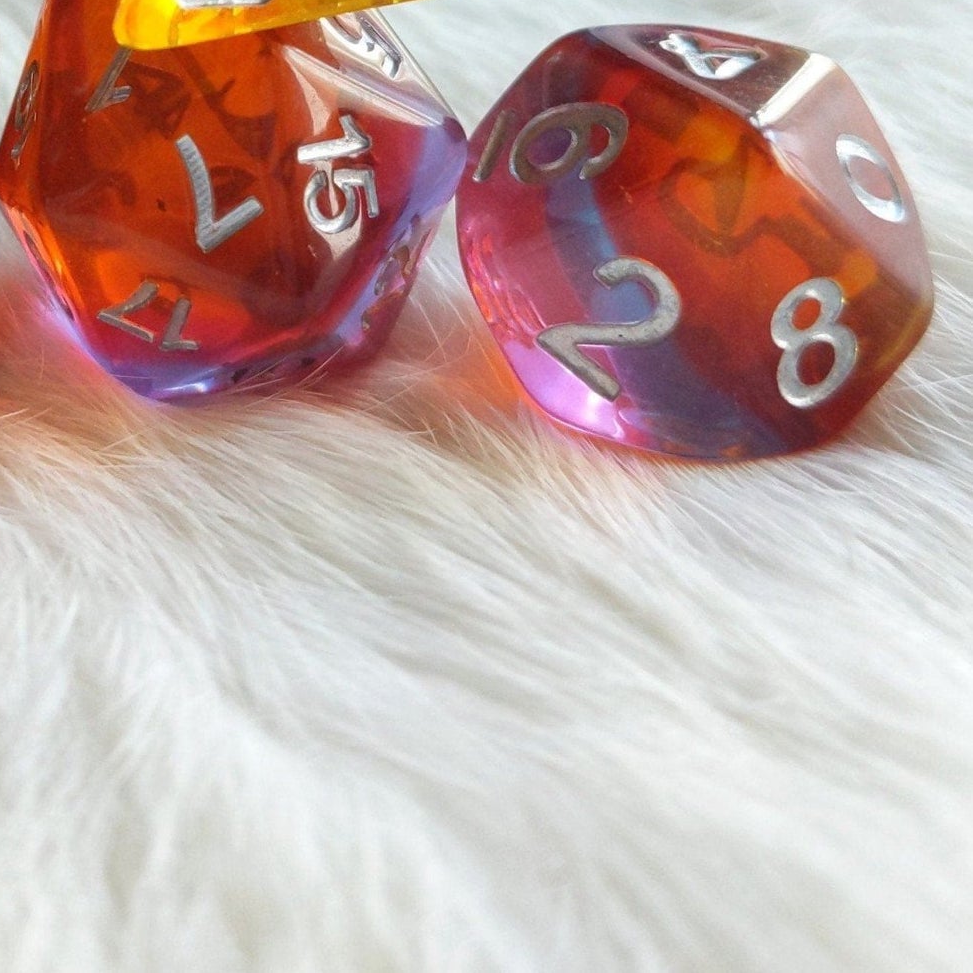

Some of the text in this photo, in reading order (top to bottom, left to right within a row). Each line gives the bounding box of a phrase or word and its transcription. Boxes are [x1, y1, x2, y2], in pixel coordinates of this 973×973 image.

[175, 133, 265, 254] 7
[296, 114, 380, 235] 15
[835, 133, 907, 224] 0
[535, 255, 683, 403] 2
[770, 276, 859, 410] 8
